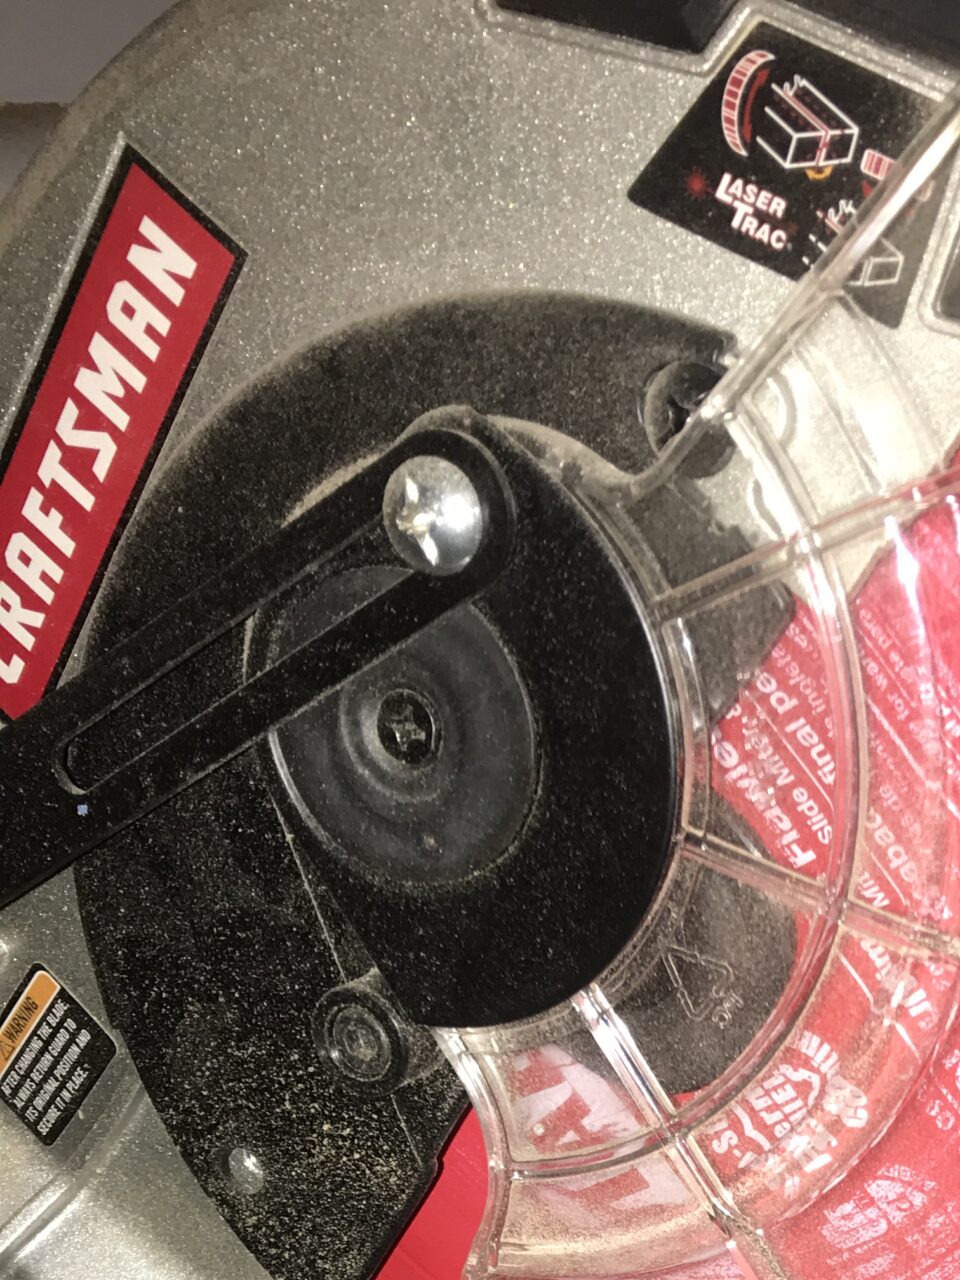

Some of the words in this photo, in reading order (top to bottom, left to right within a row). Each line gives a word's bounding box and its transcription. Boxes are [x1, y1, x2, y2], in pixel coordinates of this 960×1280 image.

[715, 172, 787, 219] LASER
[730, 200, 787, 251] TRAC
[754, 668, 799, 714] pe
[785, 716, 836, 786] final
[792, 786, 833, 845] Slide
[3, 997, 38, 1043] WARNING
[1, 1070, 21, 1096] AFTER
[15, 1036, 43, 1075] CHANGING
[37, 1022, 53, 1040] THE
[13, 1079, 36, 1109] ALWAYS
[30, 1052, 54, 1083] RETURN
[48, 1028, 70, 1056] GUARD
[63, 1018, 77, 1032] TO
[25, 1106, 38, 1122] ITS
[33, 1076, 60, 1112] ORIGINAL
[53, 1043, 81, 1081] POSITION
[75, 1029, 91, 1049] AND
[37, 1104, 62, 1135] SECURE
[55, 1096, 66, 1110] IT
[60, 1088, 72, 1102] IN
